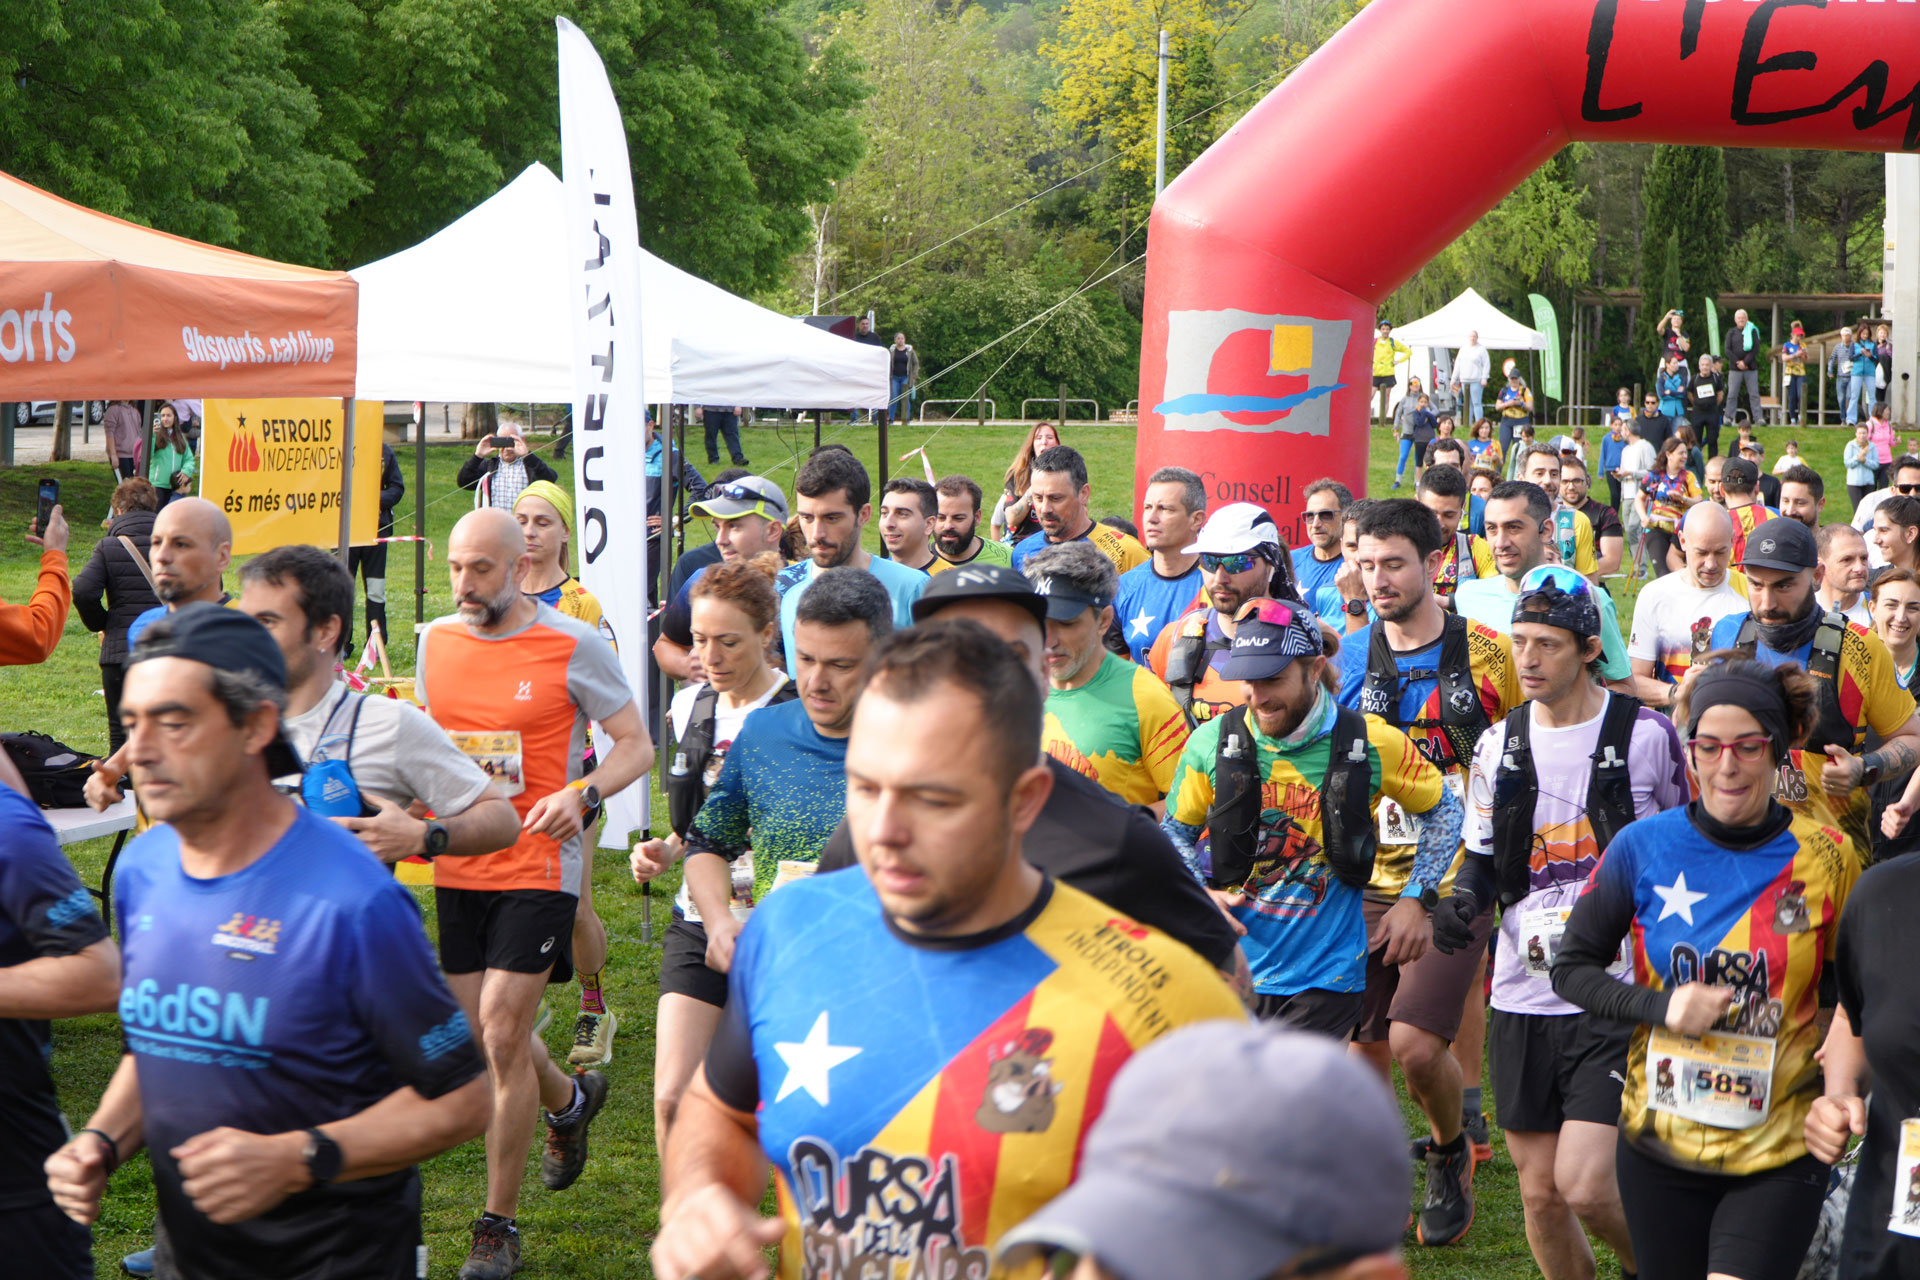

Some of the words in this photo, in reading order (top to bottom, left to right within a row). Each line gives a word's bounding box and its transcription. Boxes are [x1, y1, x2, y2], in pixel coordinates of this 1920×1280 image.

[182, 325, 335, 371] 9hsports.cat/live
[262, 418, 331, 443] PETROLIS
[224, 489, 243, 513] és
[248, 488, 280, 512] més
[285, 491, 316, 515] que
[1200, 472, 1290, 505] Consell
[1468, 631, 1506, 665] PETROLIS
[1362, 700, 1390, 713] MAX
[1696, 1069, 1753, 1097] 585
